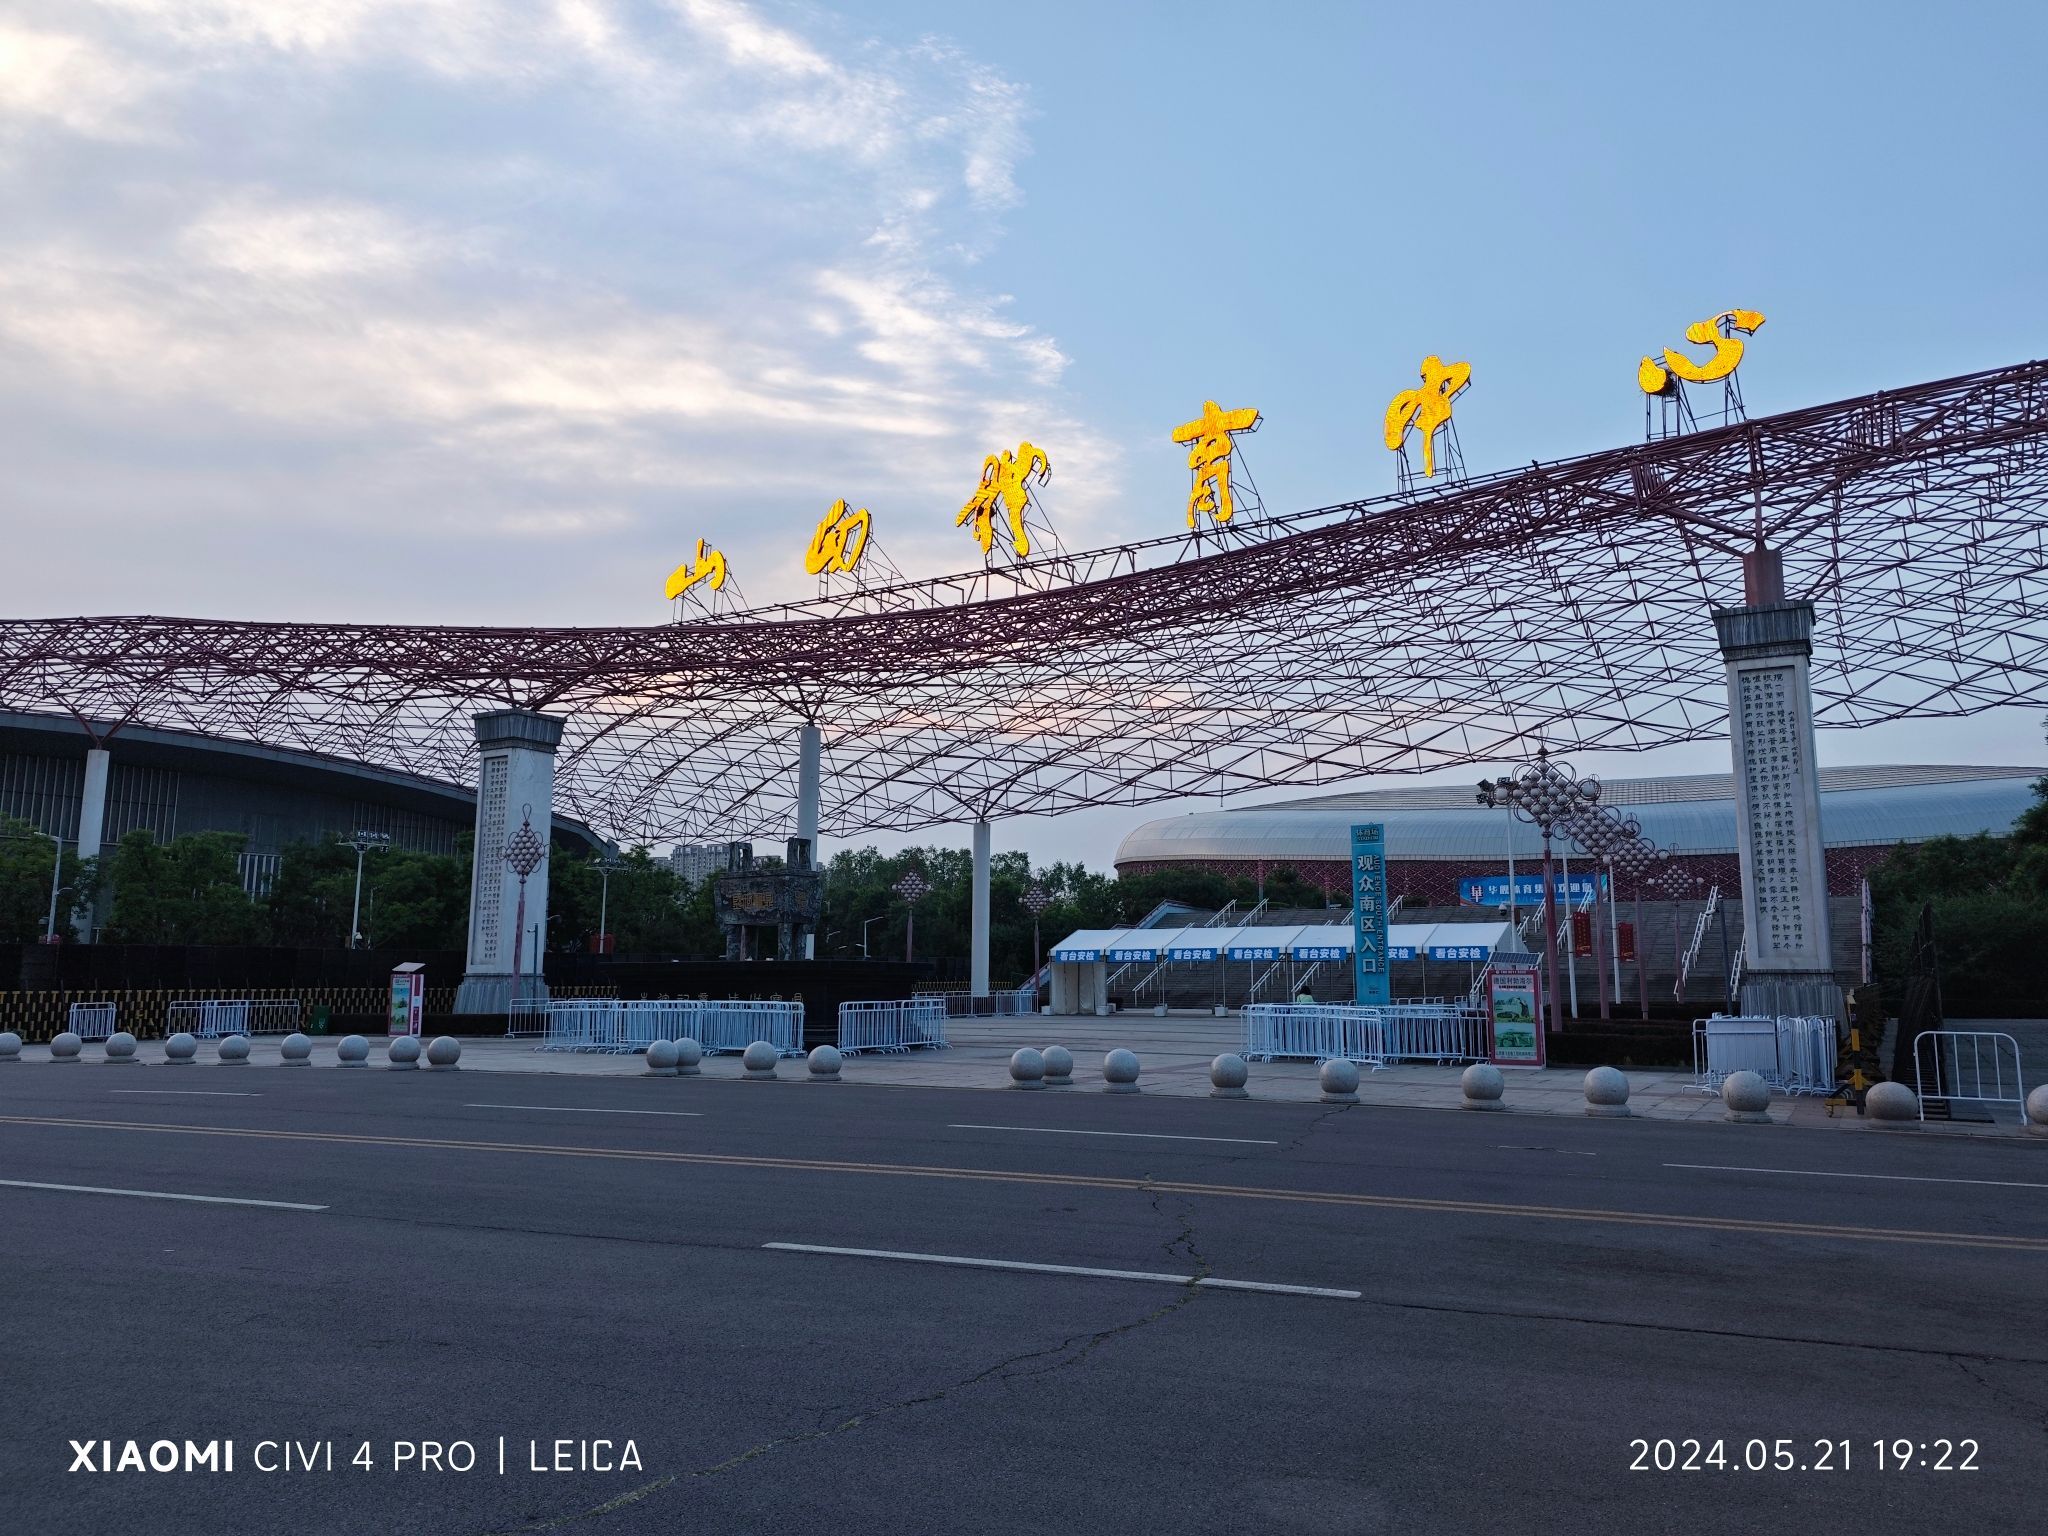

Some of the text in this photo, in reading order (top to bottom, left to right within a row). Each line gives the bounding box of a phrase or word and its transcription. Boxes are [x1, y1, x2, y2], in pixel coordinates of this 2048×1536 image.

[1357, 855, 1377, 973] 观众南区入口
[1373, 855, 1385, 973] AUDIENCE SOUTH ENTRANCE
[1059, 951, 1095, 961] 看台安检
[1114, 950, 1151, 961] 看台安检
[1173, 949, 1211, 960] 看台安检
[1233, 948, 1273, 959] 看台安检
[1298, 948, 1341, 959] 看台安检
[1435, 948, 1481, 959] 看台安检
